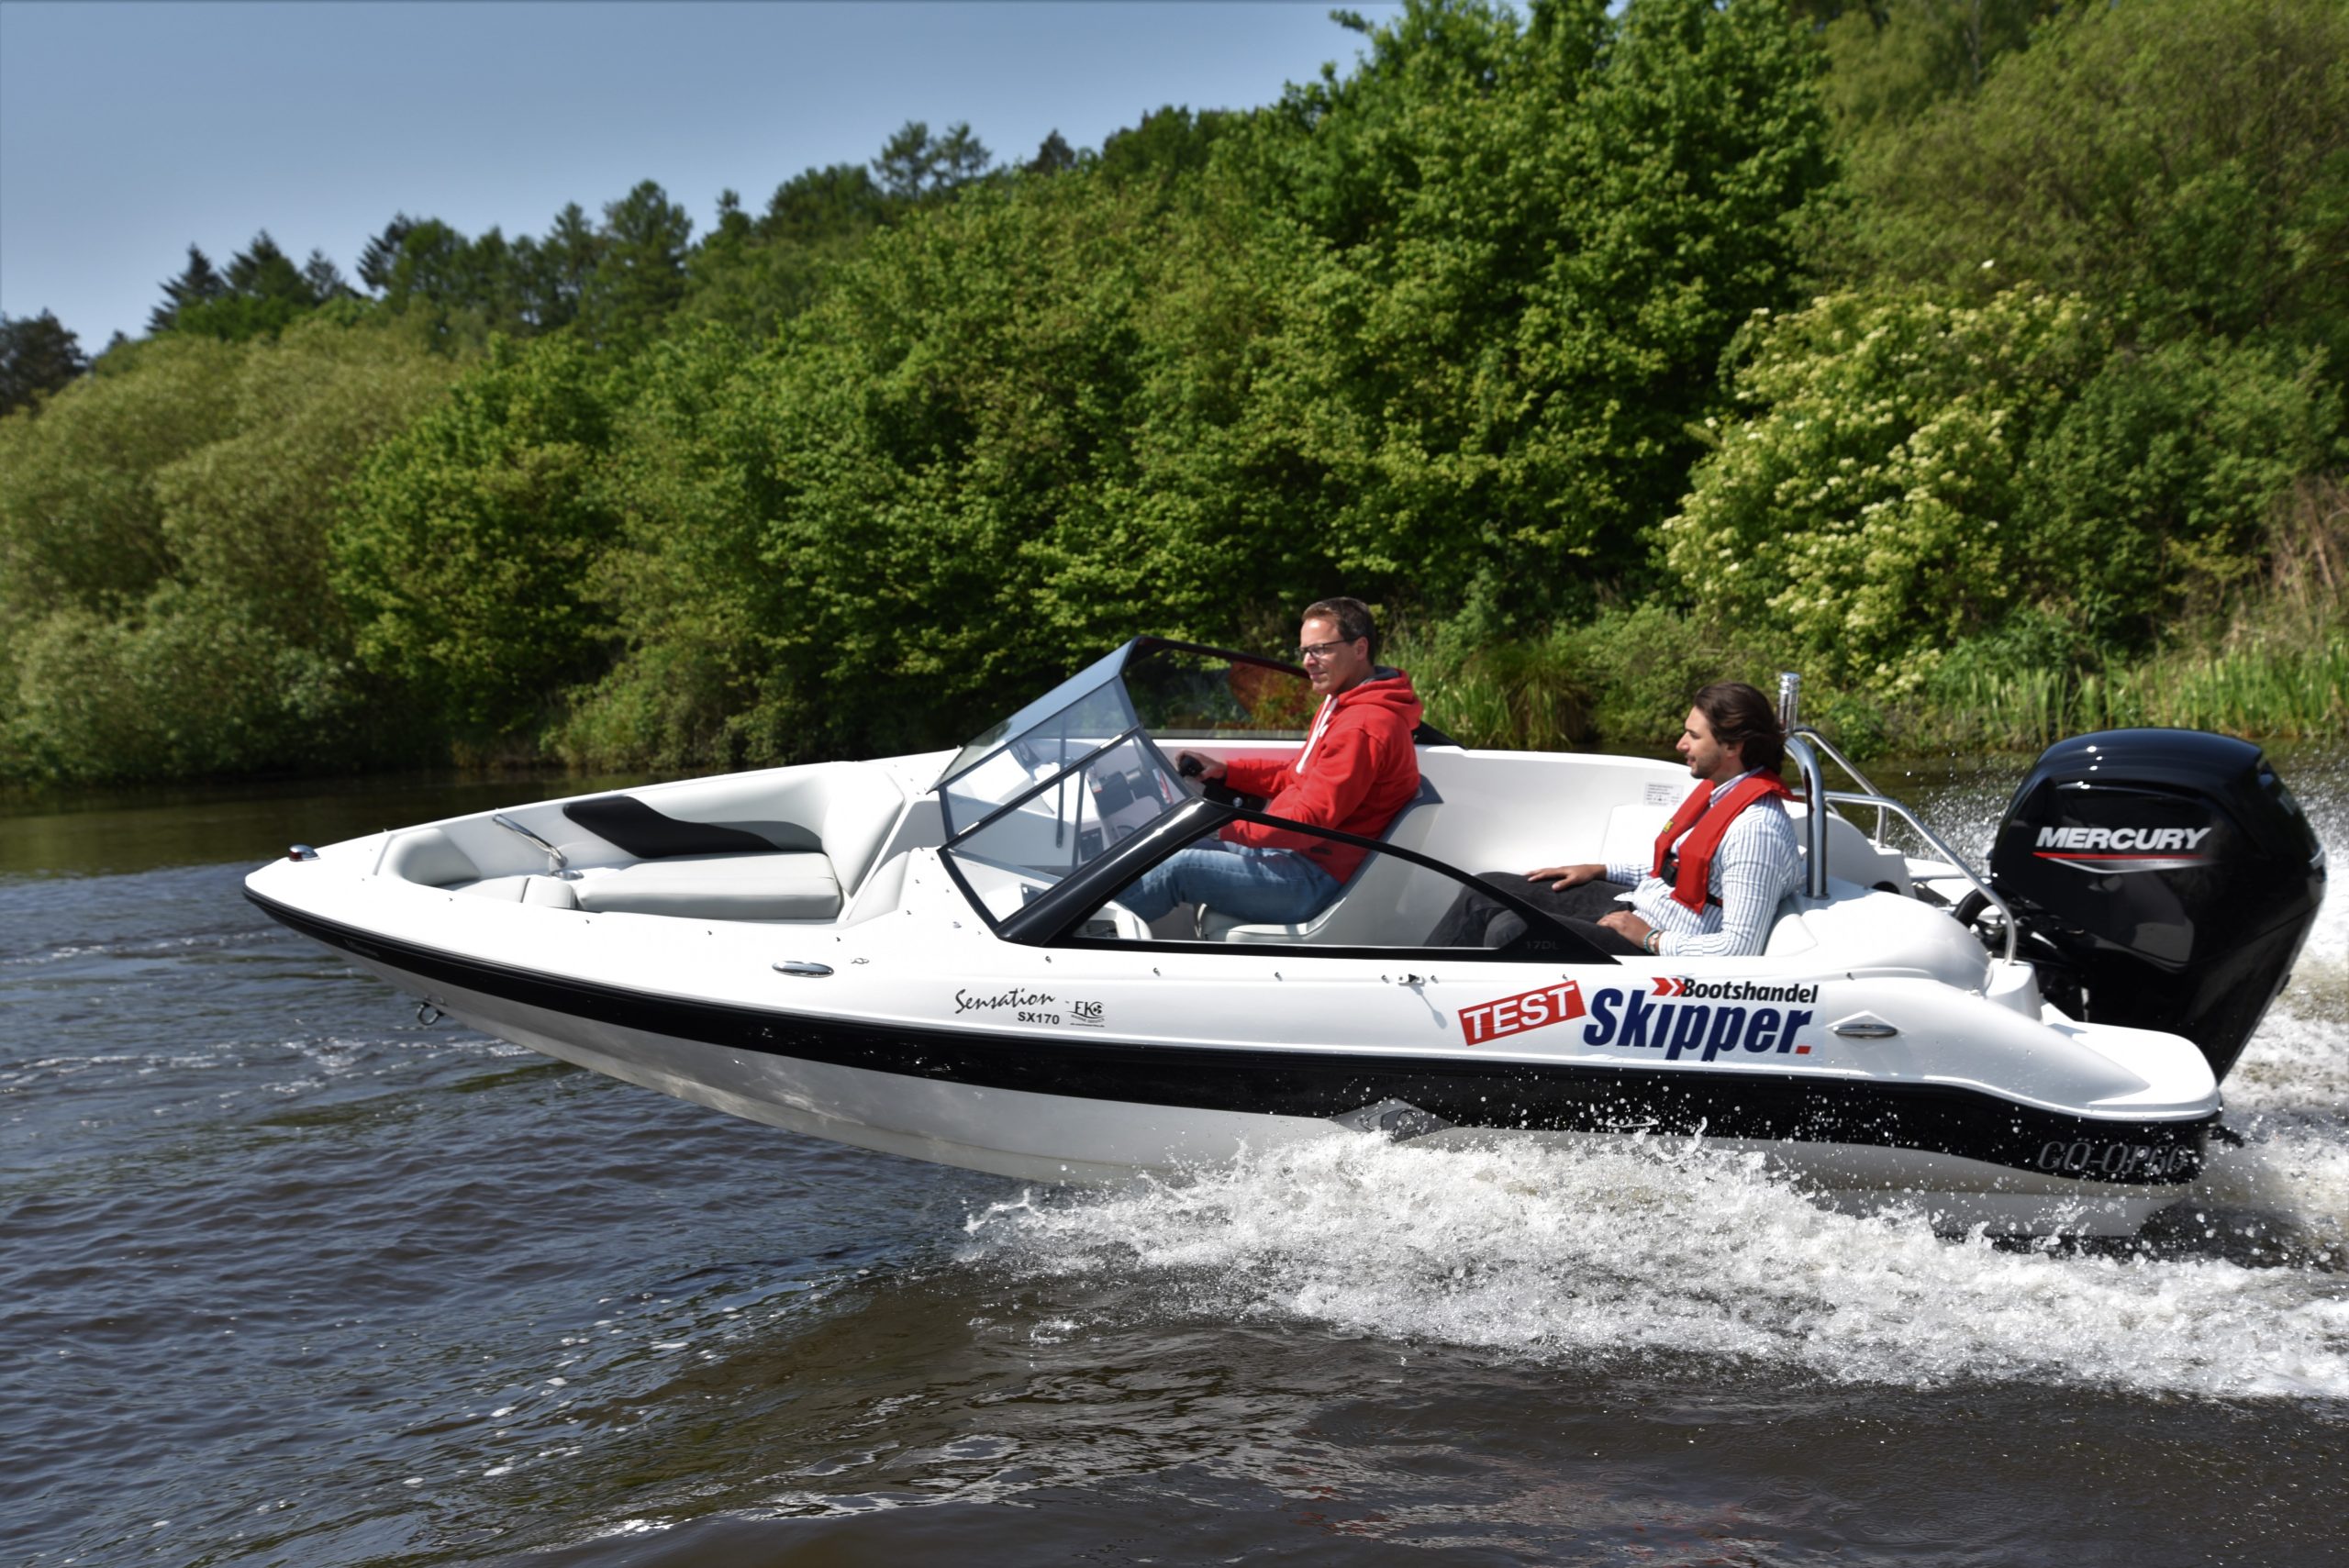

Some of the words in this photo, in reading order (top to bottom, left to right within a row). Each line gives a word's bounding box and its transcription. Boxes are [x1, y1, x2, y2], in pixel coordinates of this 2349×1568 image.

[2035, 827, 2212, 851] MERCURY
[954, 987, 1056, 1015] Sensation
[1681, 978, 1819, 1004] Bootshandel
[1017, 1011, 1061, 1026] SX170
[1463, 984, 1577, 1040] TEST
